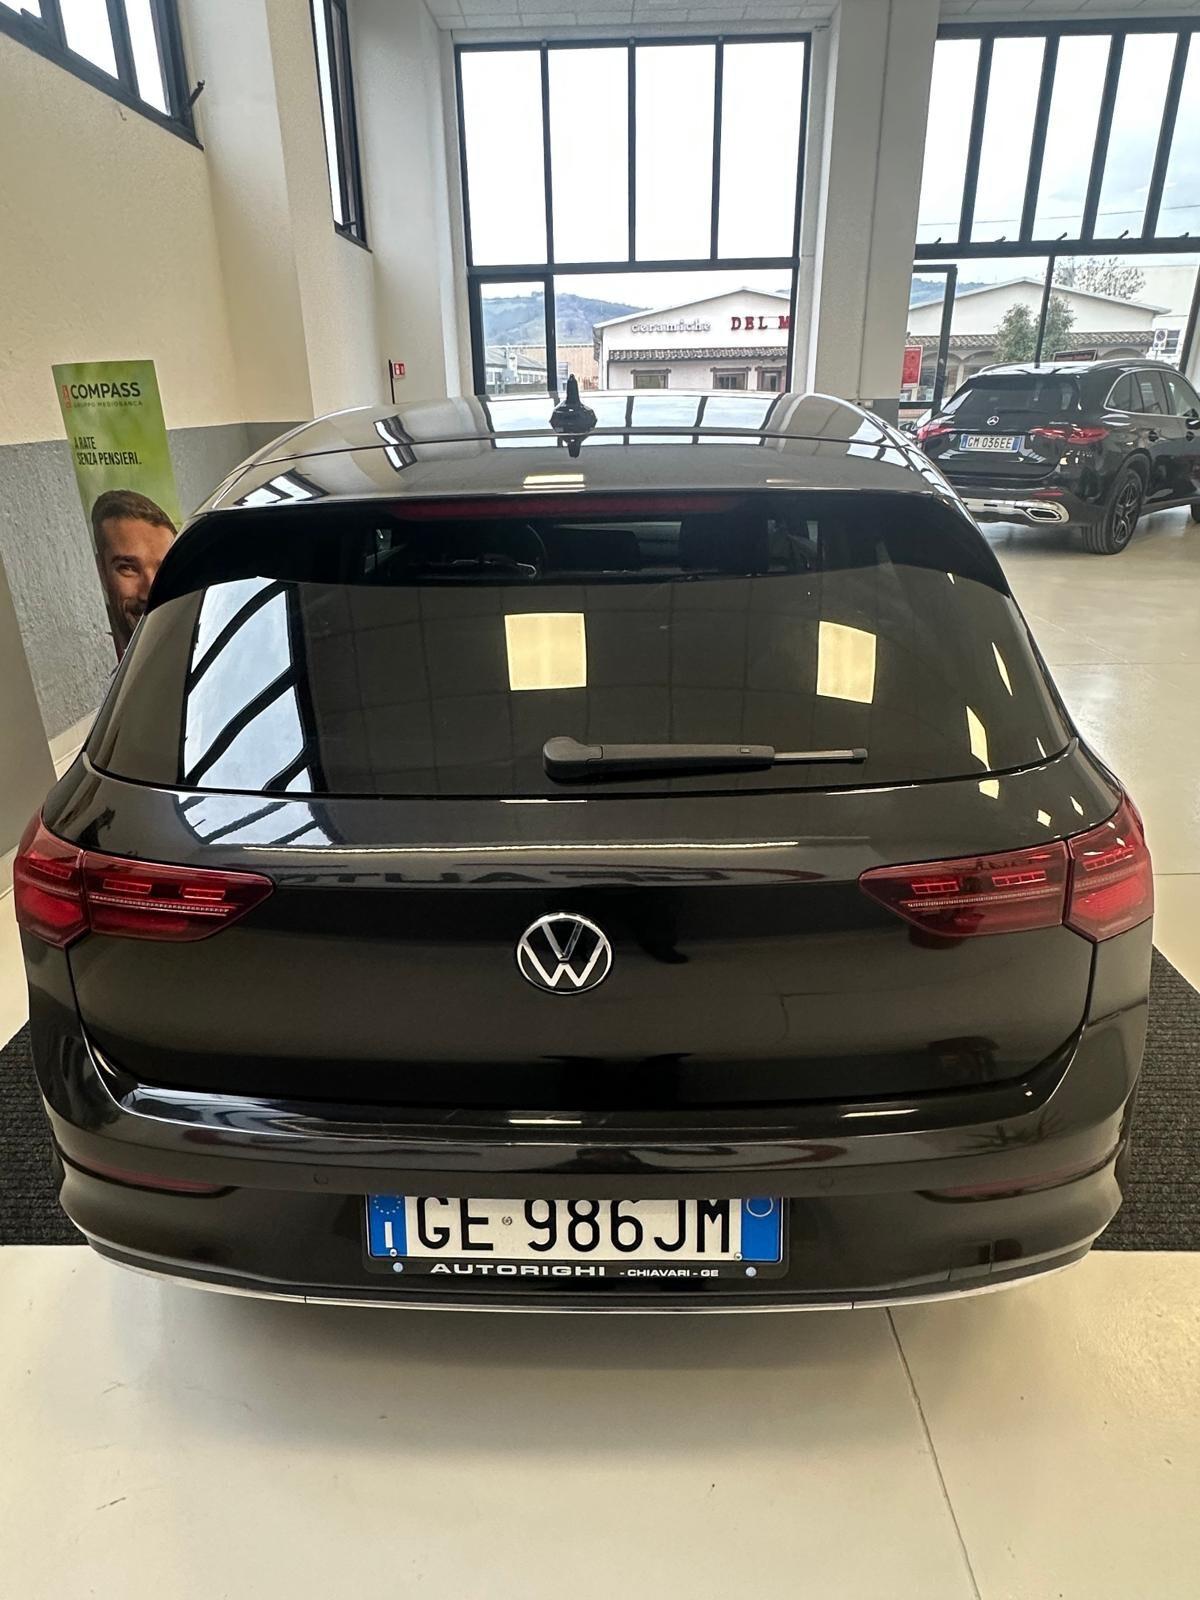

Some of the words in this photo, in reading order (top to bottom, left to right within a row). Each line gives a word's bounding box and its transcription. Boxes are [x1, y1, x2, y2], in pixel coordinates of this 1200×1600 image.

[731, 316, 768, 331] DEL
[70, 382, 141, 399] COMPASS
[79, 437, 97, 449] RATE
[982, 438, 1013, 449] 036EE
[77, 452, 98, 465] SENZA
[99, 451, 142, 465] PENSIERI.
[416, 1197, 494, 1251] GE
[524, 1199, 730, 1252] 986JM
[430, 1263, 606, 1277] AUTORIGHI
